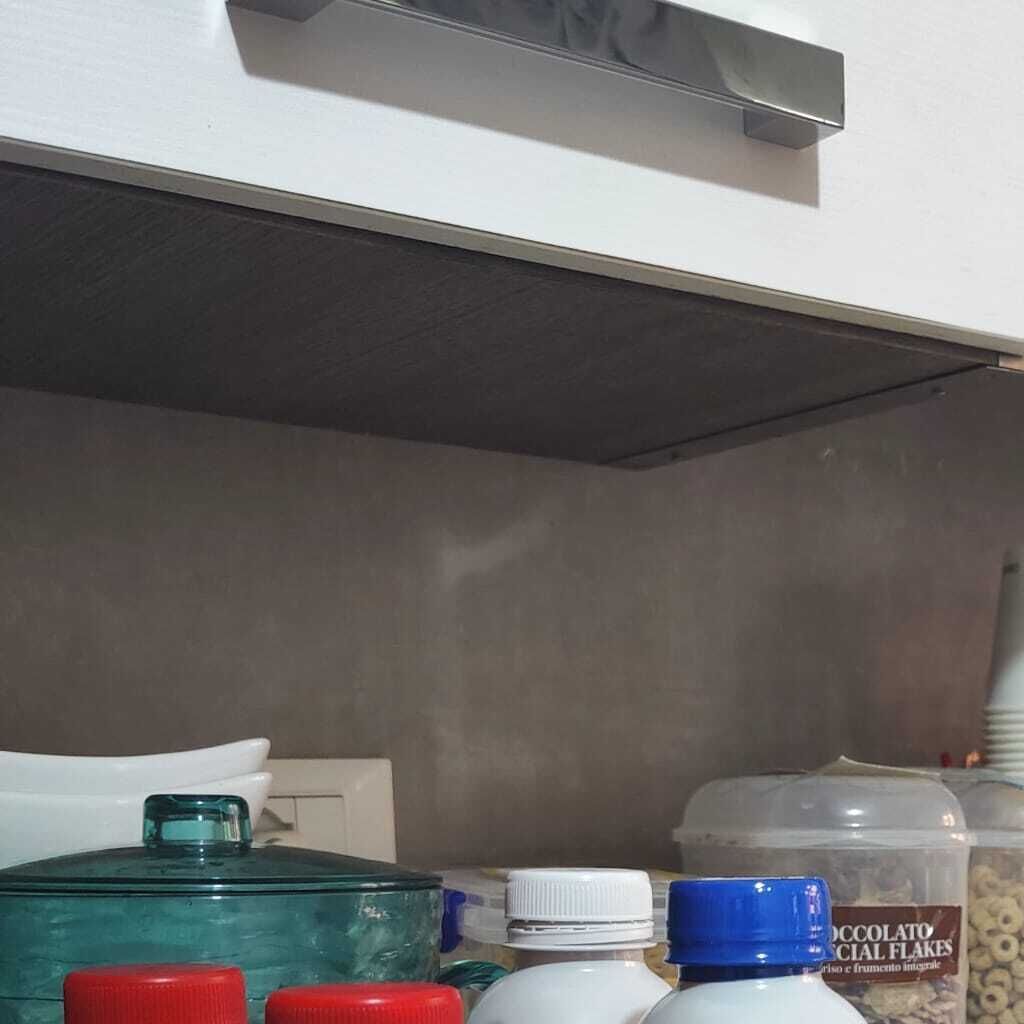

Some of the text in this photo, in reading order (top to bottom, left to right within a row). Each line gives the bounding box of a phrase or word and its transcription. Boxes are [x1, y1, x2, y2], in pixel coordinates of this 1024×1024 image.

[832, 938, 953, 961] CIAL FLAKES
[853, 961, 902, 974] frumento
[902, 960, 941, 973] integrale
